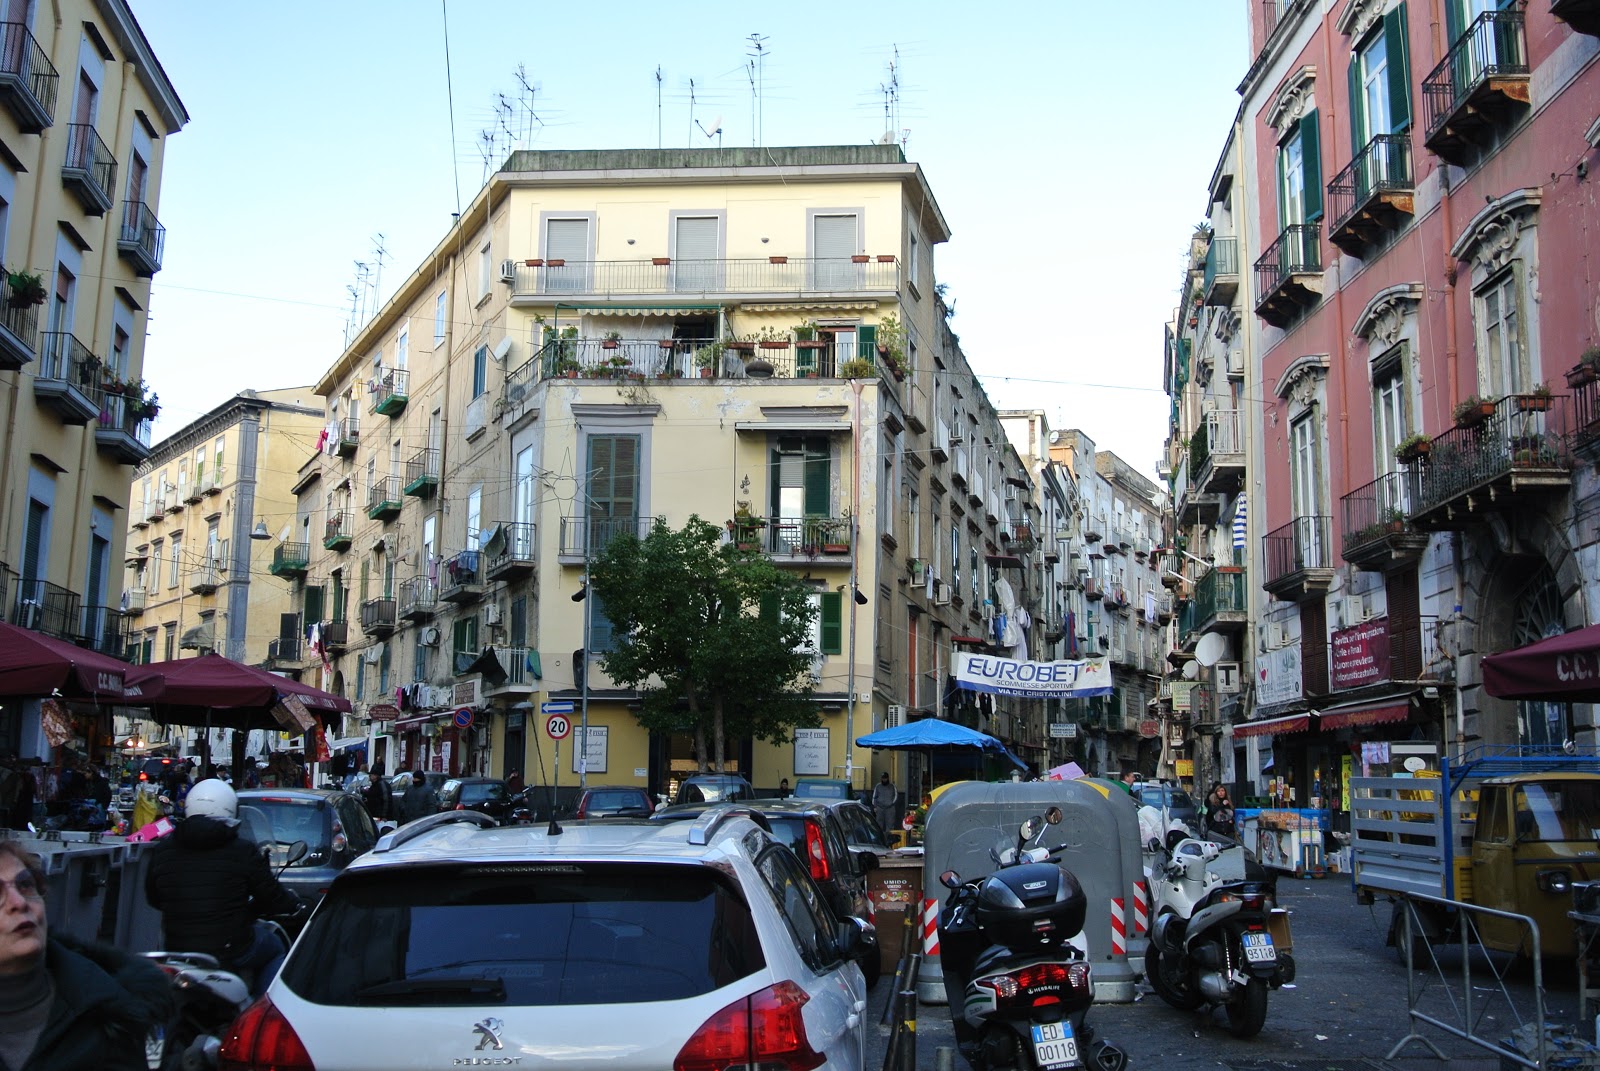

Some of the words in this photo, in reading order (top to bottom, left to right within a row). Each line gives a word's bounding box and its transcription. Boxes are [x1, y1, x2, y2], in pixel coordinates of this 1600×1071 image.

[967, 657, 1085, 682] EUROBET
[996, 679, 1040, 689] SCOMMESSE
[551, 720, 566, 733] 20
[1250, 935, 1262, 946] DX
[1248, 947, 1274, 960] 93118
[1034, 985, 1060, 993] HERBALIFE
[1042, 1024, 1058, 1040] ED
[1038, 1042, 1076, 1061] 00118
[453, 1056, 522, 1066] PEUGEOT
